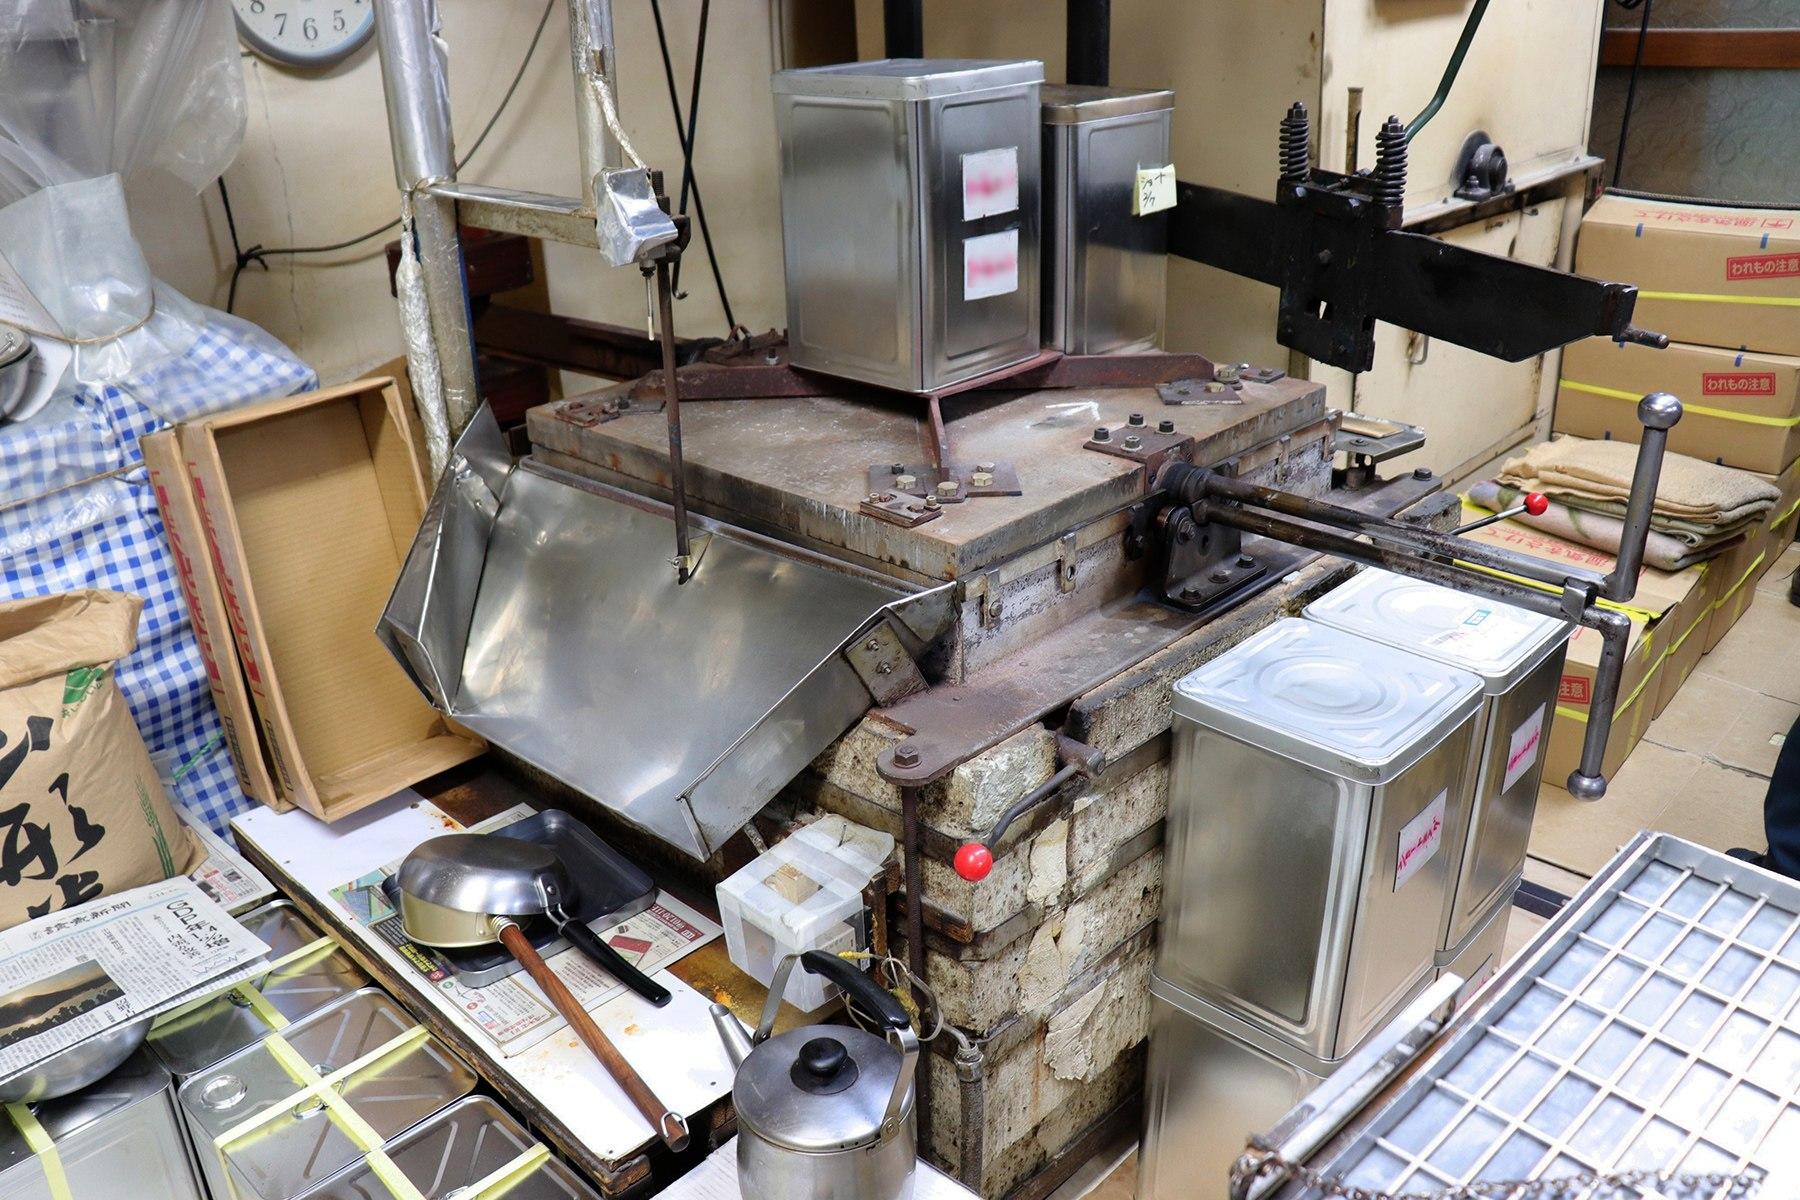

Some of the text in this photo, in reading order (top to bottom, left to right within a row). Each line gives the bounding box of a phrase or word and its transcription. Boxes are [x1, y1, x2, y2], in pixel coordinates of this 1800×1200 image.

[250, 0, 265, 14] 8
[274, 13, 287, 36] 7
[303, 17, 319, 41] 6
[333, 10, 345, 32] 5
[1732, 258, 1800, 275] われもの注意
[1707, 377, 1771, 391] われもの注意
